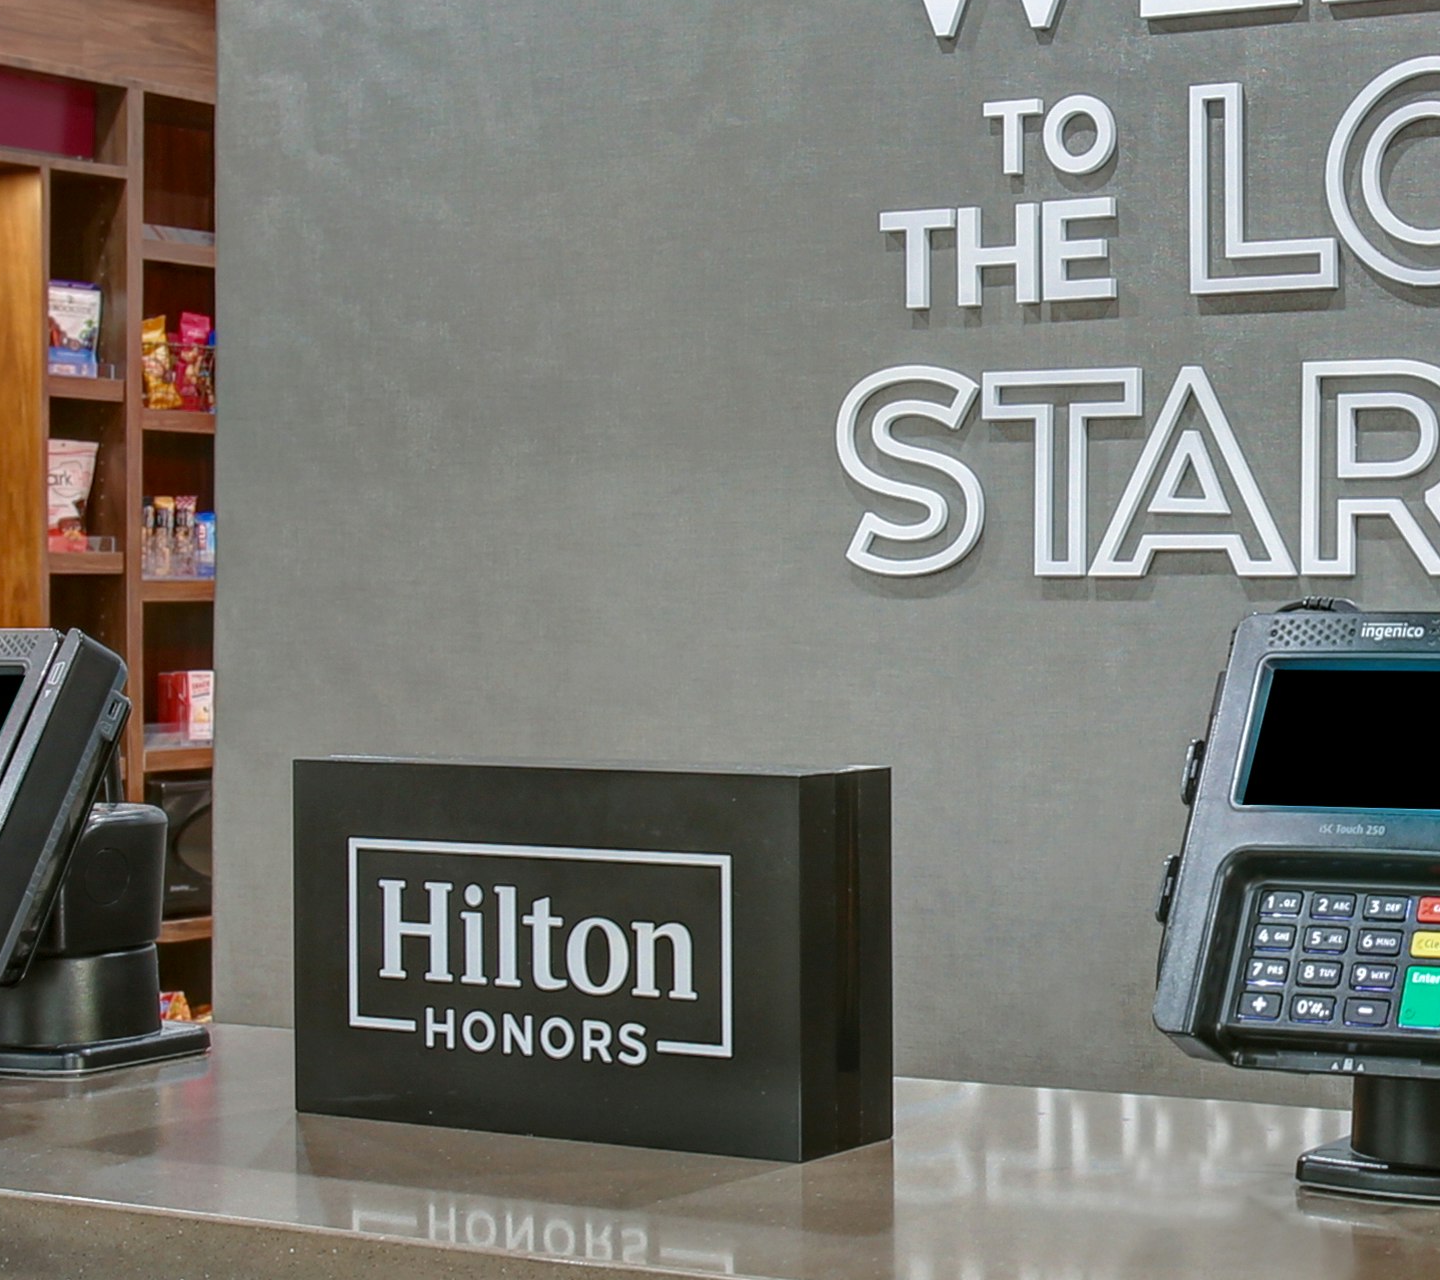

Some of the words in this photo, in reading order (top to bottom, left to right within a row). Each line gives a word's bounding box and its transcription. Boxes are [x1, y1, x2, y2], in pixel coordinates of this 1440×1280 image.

[983, 93, 1118, 176] TO
[879, 196, 1118, 310] THE
[1361, 622, 1425, 641] ingenico
[1336, 823, 1364, 835] Touch
[1365, 824, 1386, 836] 250
[1266, 896, 1275, 909] 1
[1317, 898, 1328, 912] 2
[1332, 902, 1351, 912] ABC
[1369, 900, 1380, 913] 3
[377, 877, 698, 1002] Hilton
[1258, 929, 1269, 942] 4
[1311, 931, 1322, 945] 5
[1362, 934, 1373, 948] 6
[1375, 938, 1396, 947] MNO
[1253, 962, 1263, 976] 7
[1303, 965, 1315, 979] 8
[1355, 967, 1367, 981] 9
[424, 1006, 649, 1067] HONORS
